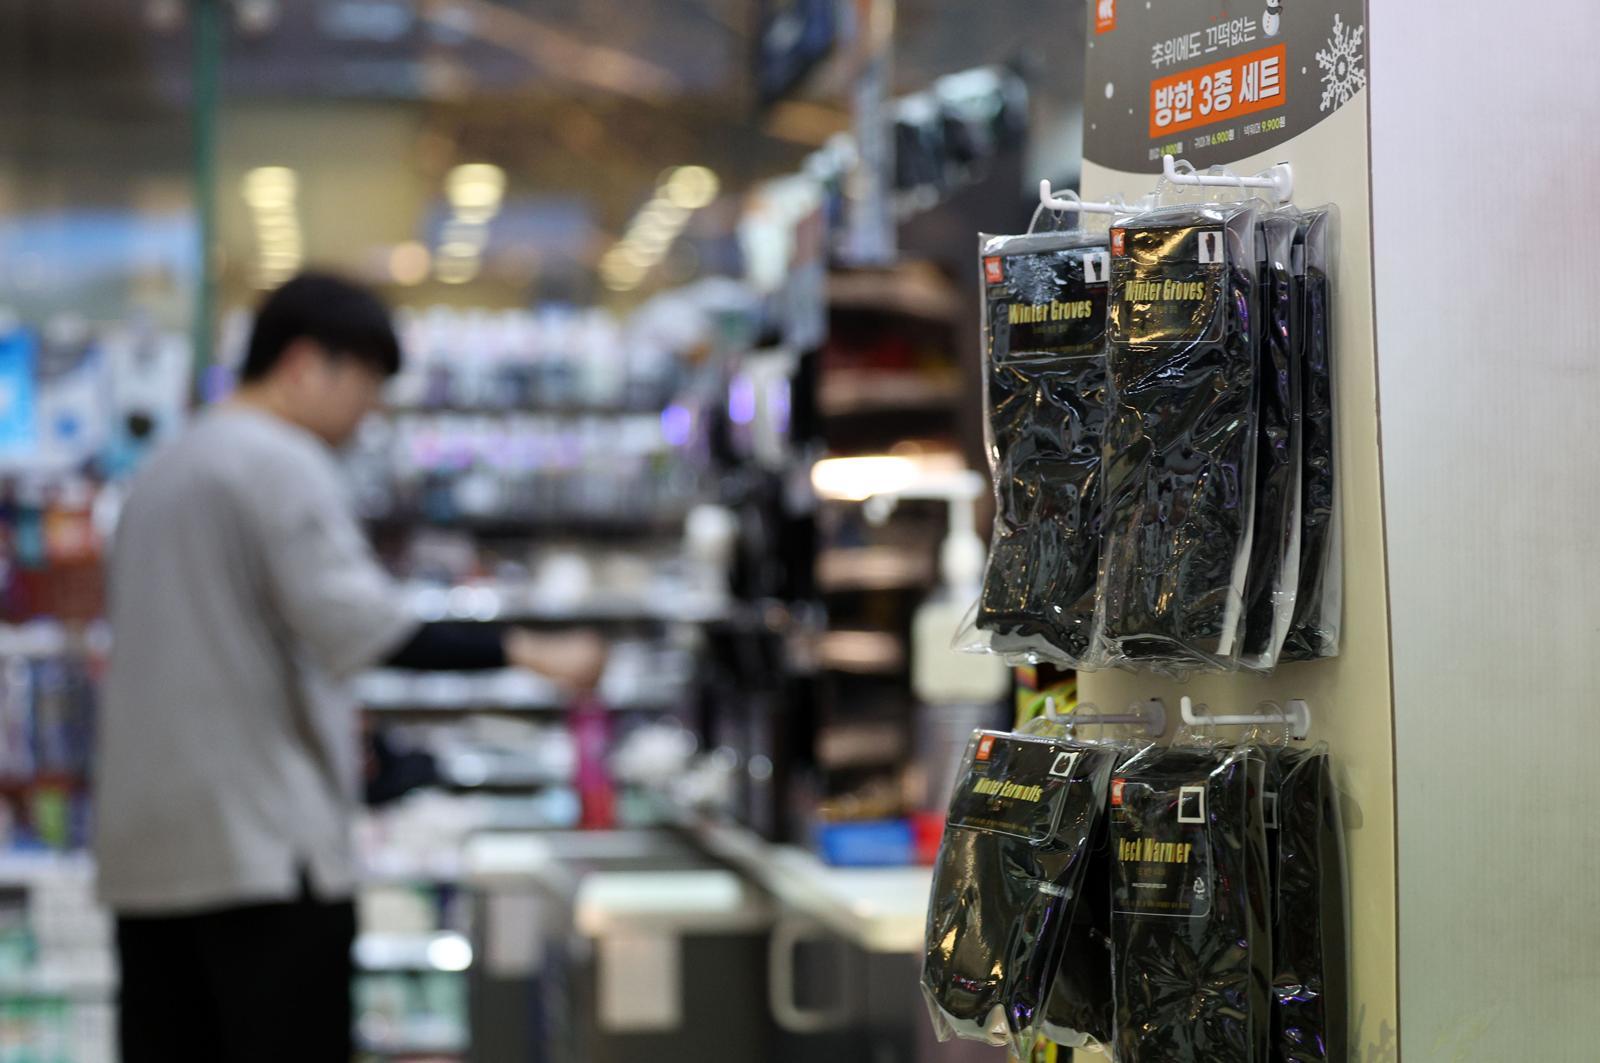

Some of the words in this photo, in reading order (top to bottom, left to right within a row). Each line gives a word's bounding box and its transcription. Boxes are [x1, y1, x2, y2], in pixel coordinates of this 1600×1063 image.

[1151, 32, 1201, 69] 추위에도
[1205, 16, 1257, 53] 끄떡없는
[1154, 81, 1195, 127] 방한
[1199, 69, 1233, 116] 3종
[1239, 56, 1281, 103] 세트
[1124, 280, 1162, 301] Winter
[1163, 279, 1205, 301] Groves
[1008, 303, 1048, 324] Winter
[1050, 299, 1092, 321] Groves
[972, 777, 1004, 795] Winter
[999, 780, 1044, 803] Earmuffs
[1119, 837, 1141, 862] Neck
[1143, 838, 1193, 864] Warmer
